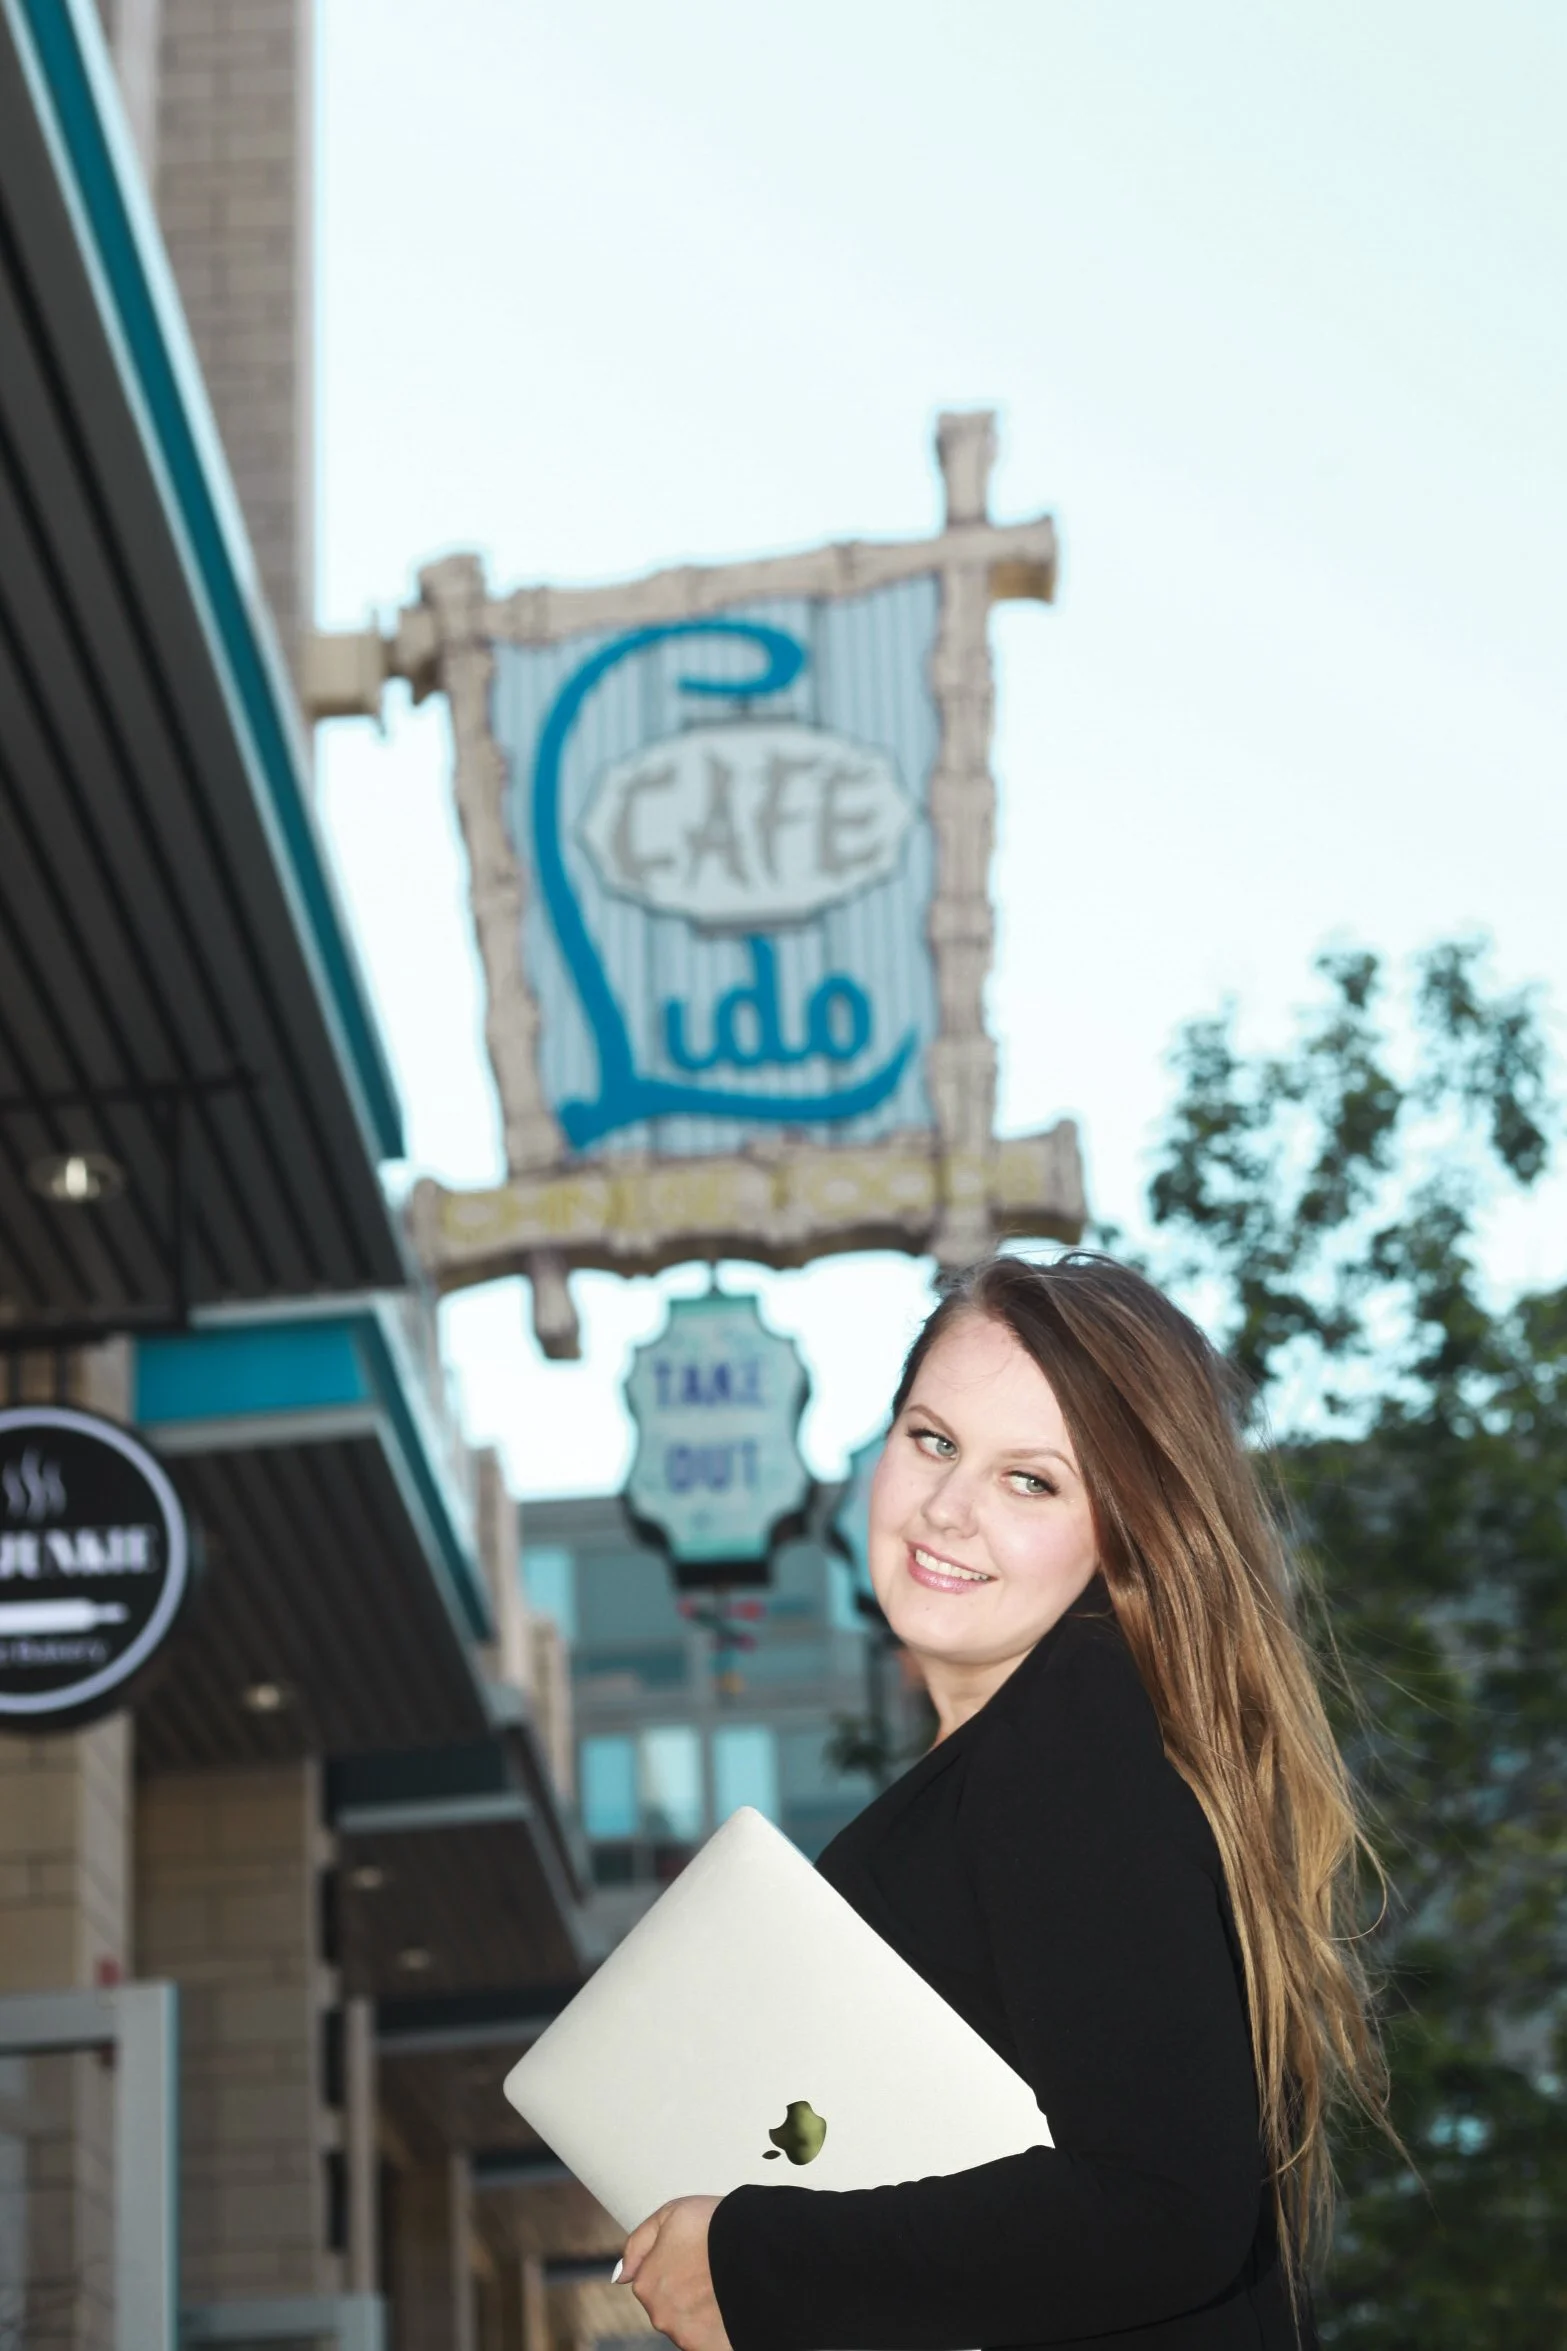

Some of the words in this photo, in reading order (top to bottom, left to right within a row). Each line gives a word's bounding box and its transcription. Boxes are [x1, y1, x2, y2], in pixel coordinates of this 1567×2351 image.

[532, 620, 917, 1148] Lido
[610, 748, 882, 892] CAFE
[665, 1438, 760, 1494] OUT
